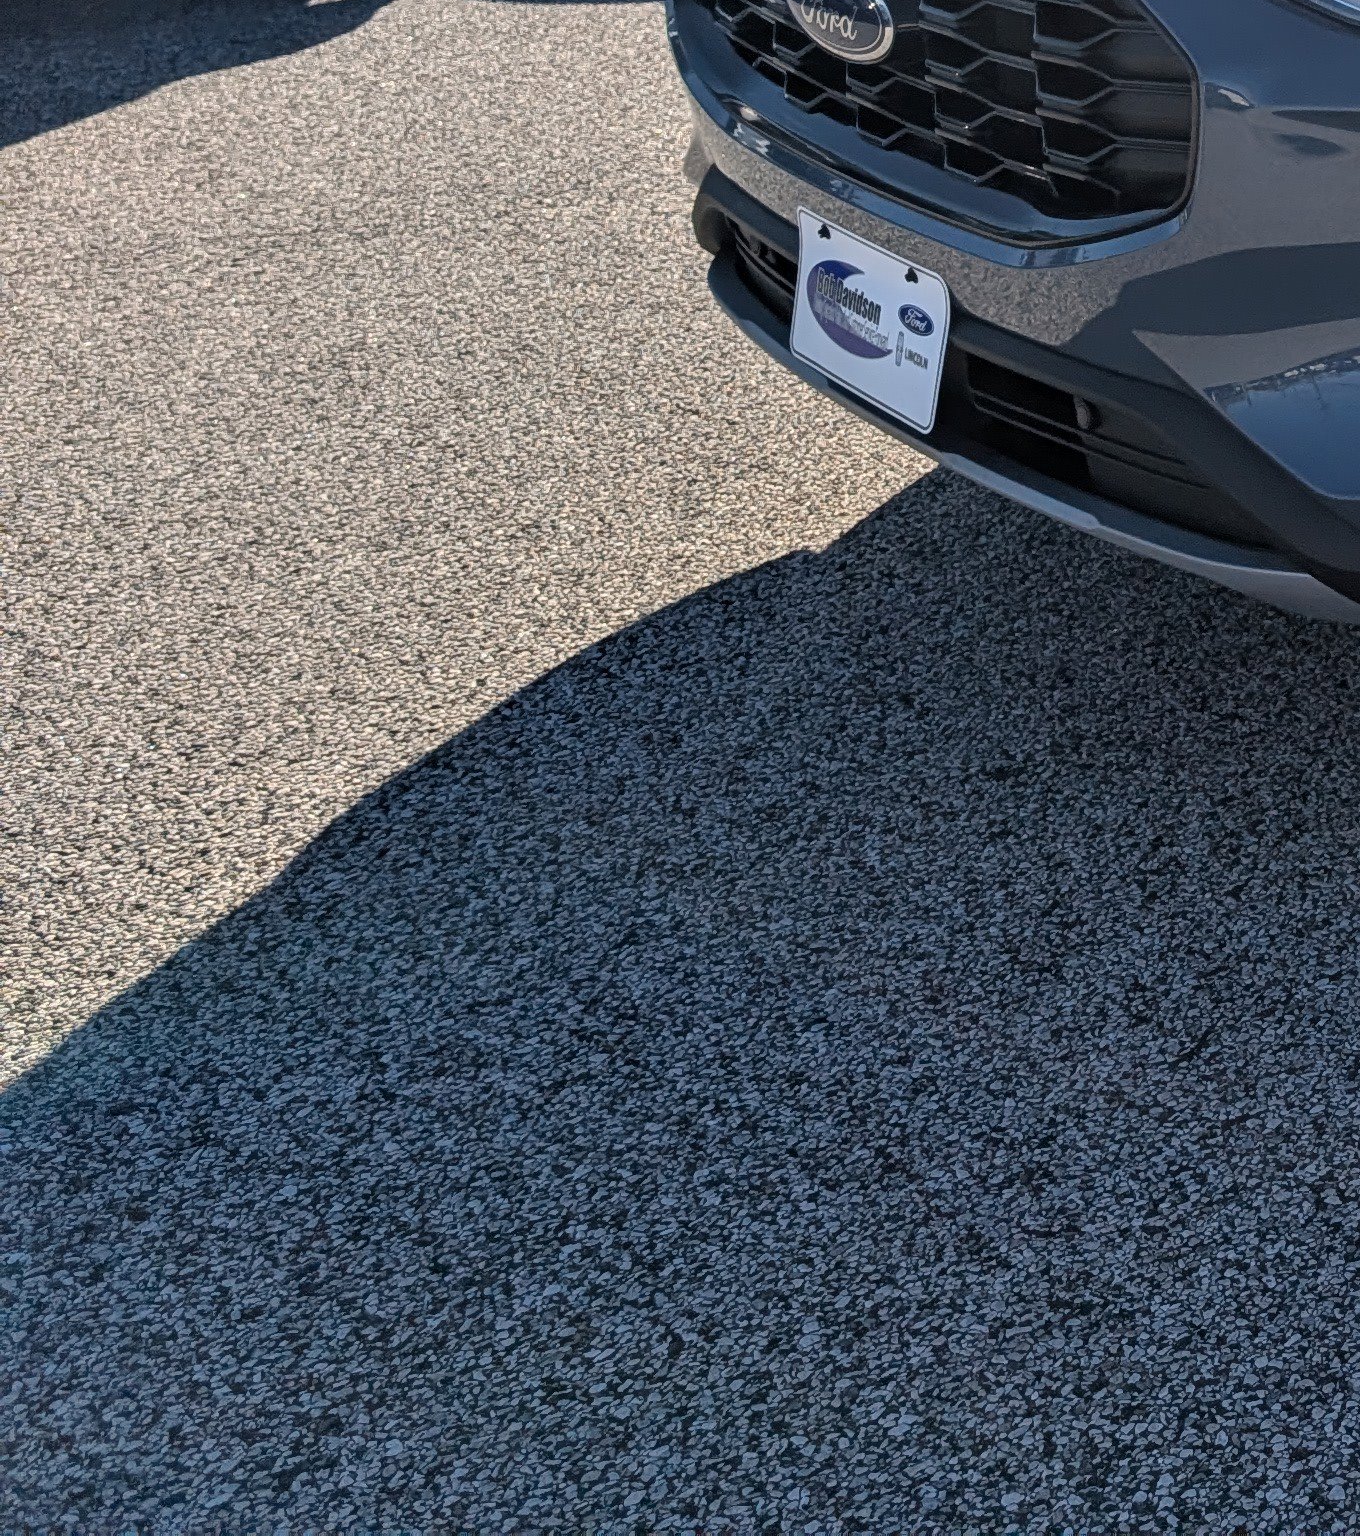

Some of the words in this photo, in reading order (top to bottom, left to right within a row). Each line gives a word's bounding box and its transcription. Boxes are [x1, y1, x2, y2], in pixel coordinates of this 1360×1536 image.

[816, 266, 836, 301] Bob
[836, 277, 882, 326] Davidson
[904, 308, 929, 333] Ford
[904, 347, 928, 370] LINCOLN
